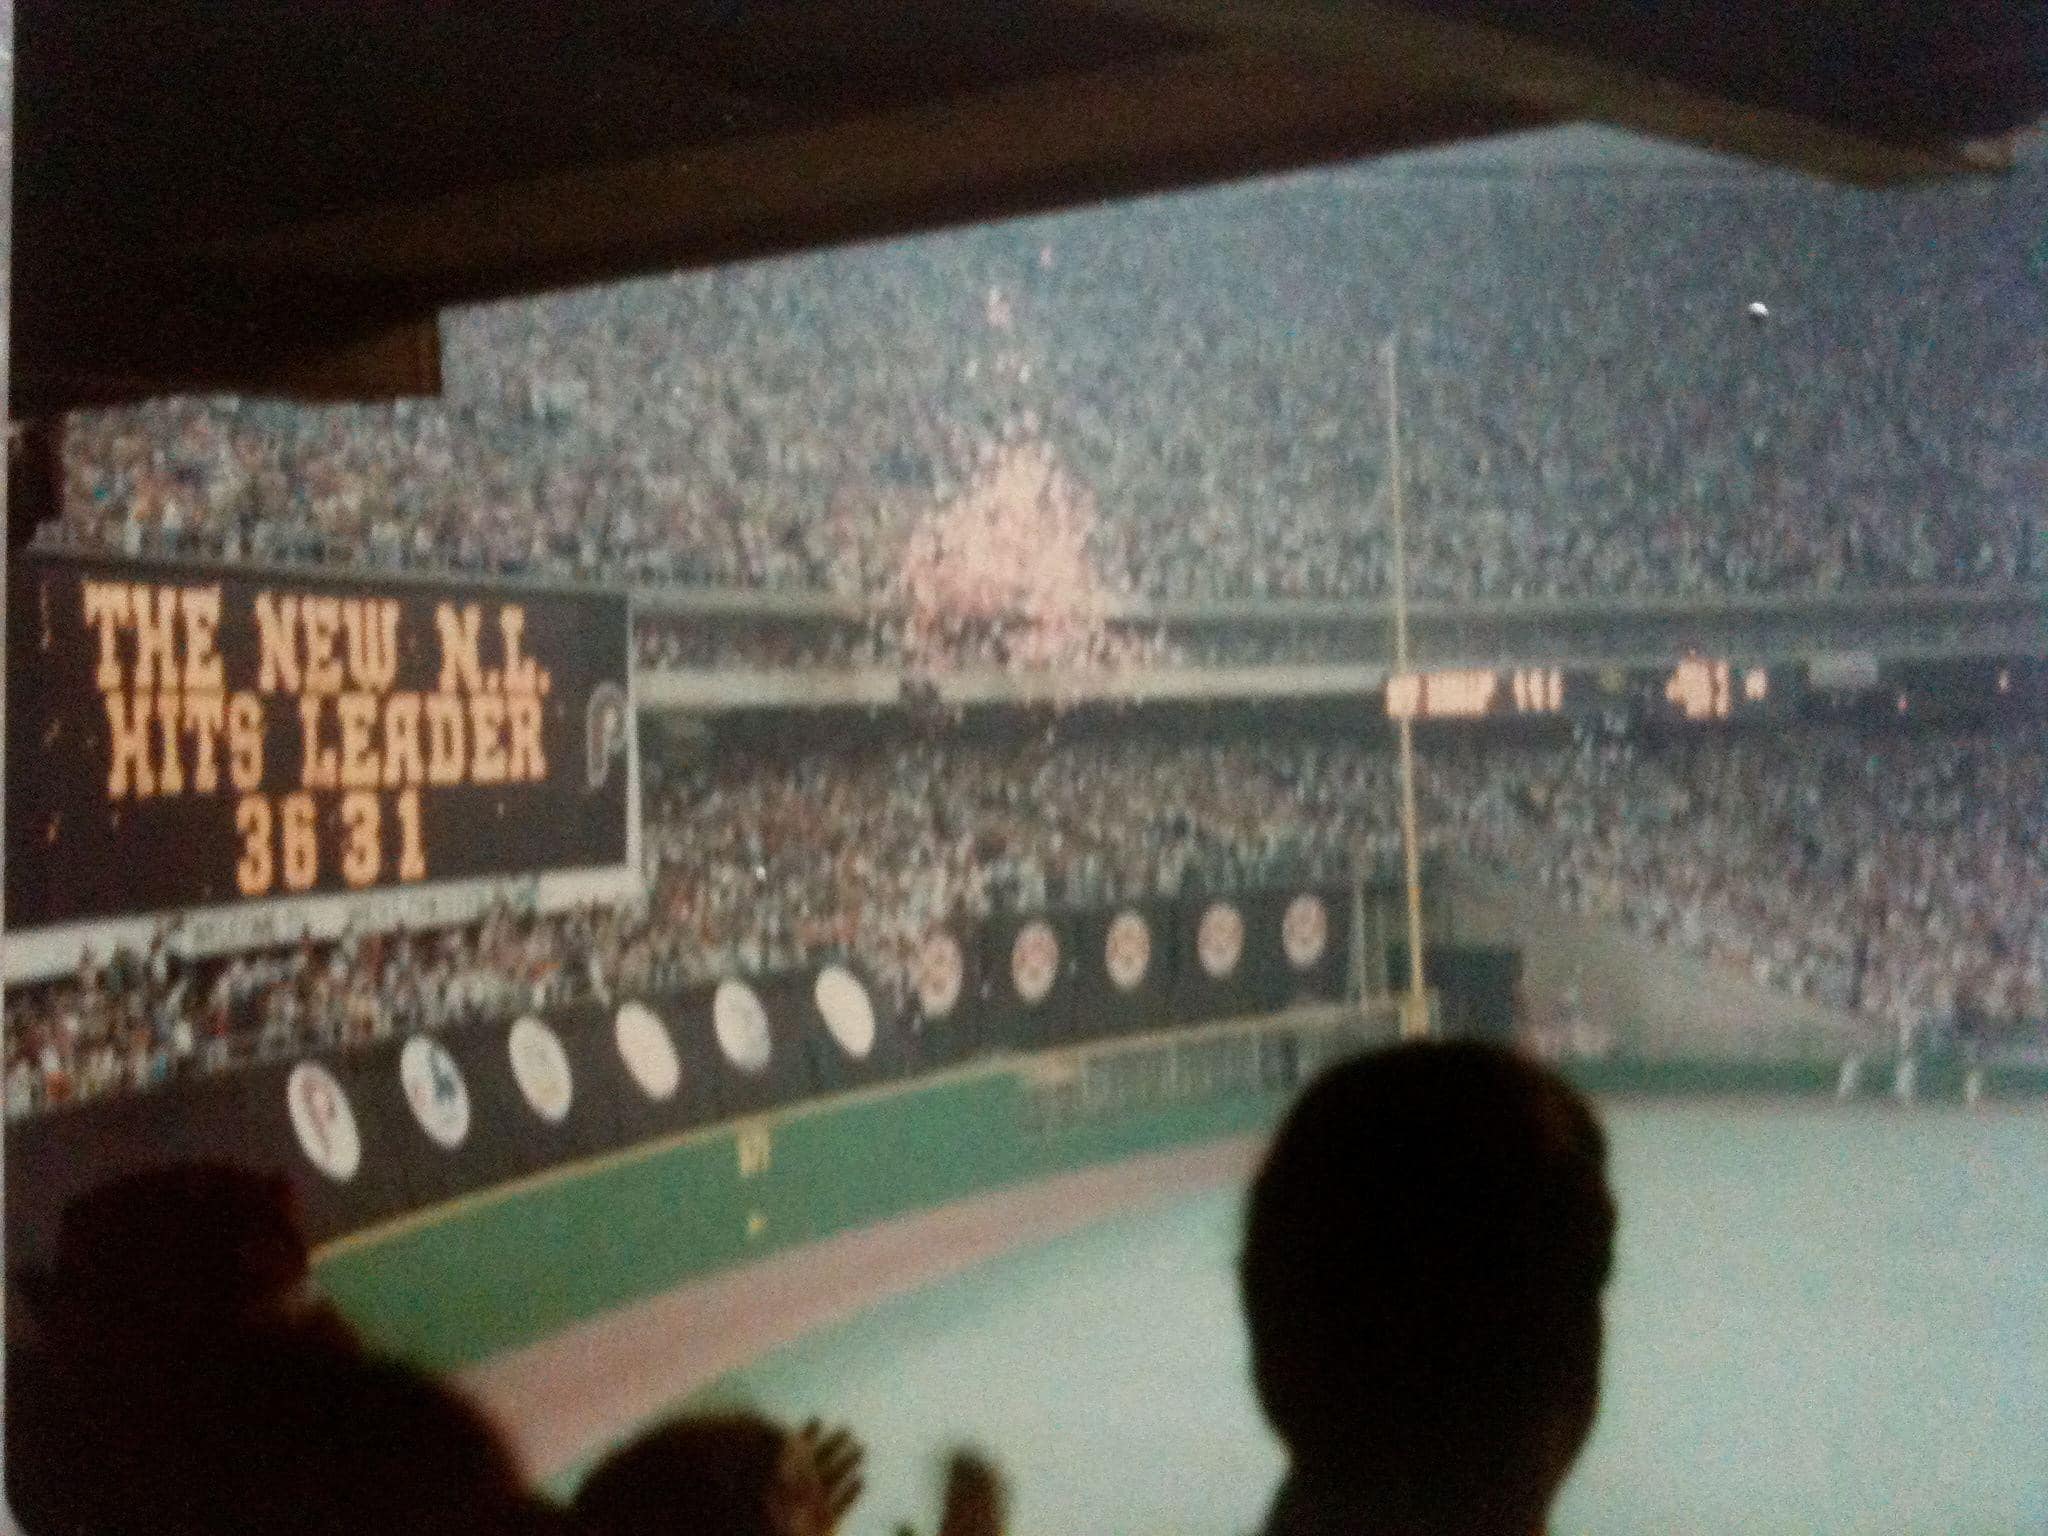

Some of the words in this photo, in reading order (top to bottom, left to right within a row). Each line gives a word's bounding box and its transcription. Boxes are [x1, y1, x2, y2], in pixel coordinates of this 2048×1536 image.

[83, 580, 224, 689] THE
[256, 594, 399, 694] NEW
[106, 688, 265, 797] HITS
[301, 690, 547, 788] LEADER
